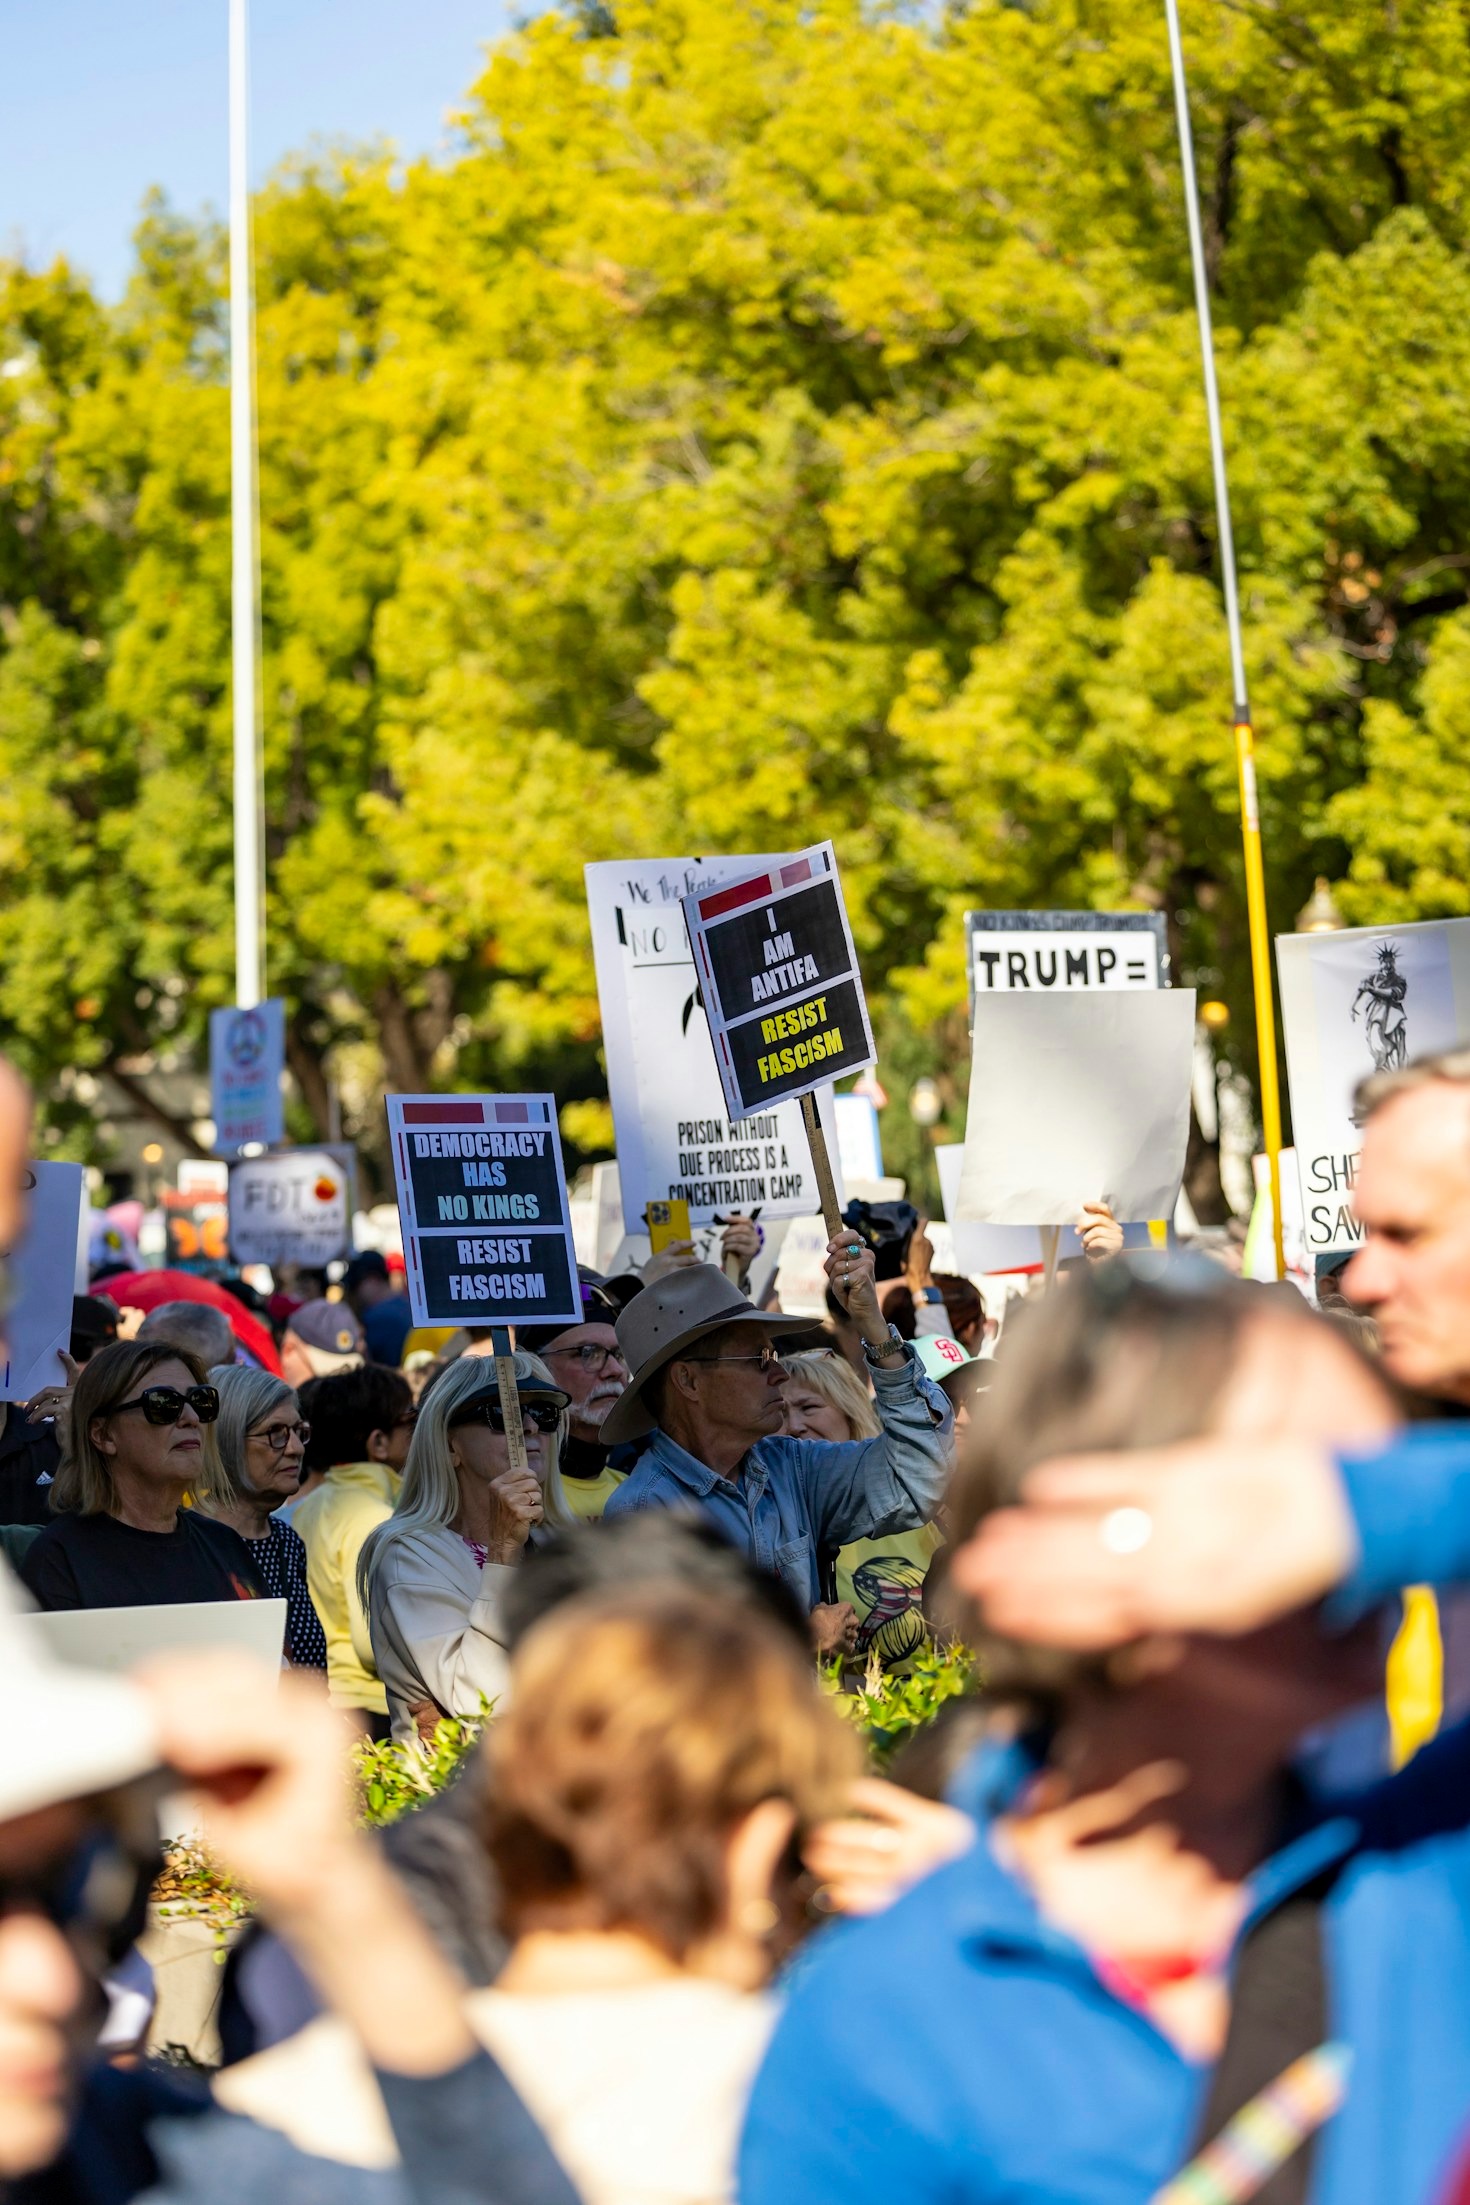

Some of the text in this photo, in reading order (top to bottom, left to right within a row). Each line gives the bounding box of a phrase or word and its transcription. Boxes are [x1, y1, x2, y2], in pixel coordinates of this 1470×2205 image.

[766, 907, 777, 933] I
[631, 926, 667, 957] NO
[763, 931, 795, 967] AM
[750, 953, 820, 1003] ANTIFA
[760, 996, 827, 1045] RESIST
[757, 1027, 844, 1084] FASCISM
[413, 1132, 546, 1158] DEMOCRACY
[678, 1115, 778, 1147] PRISON WITHOUT
[462, 1161, 507, 1187] HAS
[679, 1144, 789, 1178] DUE PROCESS IS A
[668, 1174, 802, 1207] CONCENTRATION CAMP
[437, 1193, 540, 1221] NO KINGS
[456, 1238, 532, 1265] RESIST
[448, 1272, 546, 1301] FASCISM
